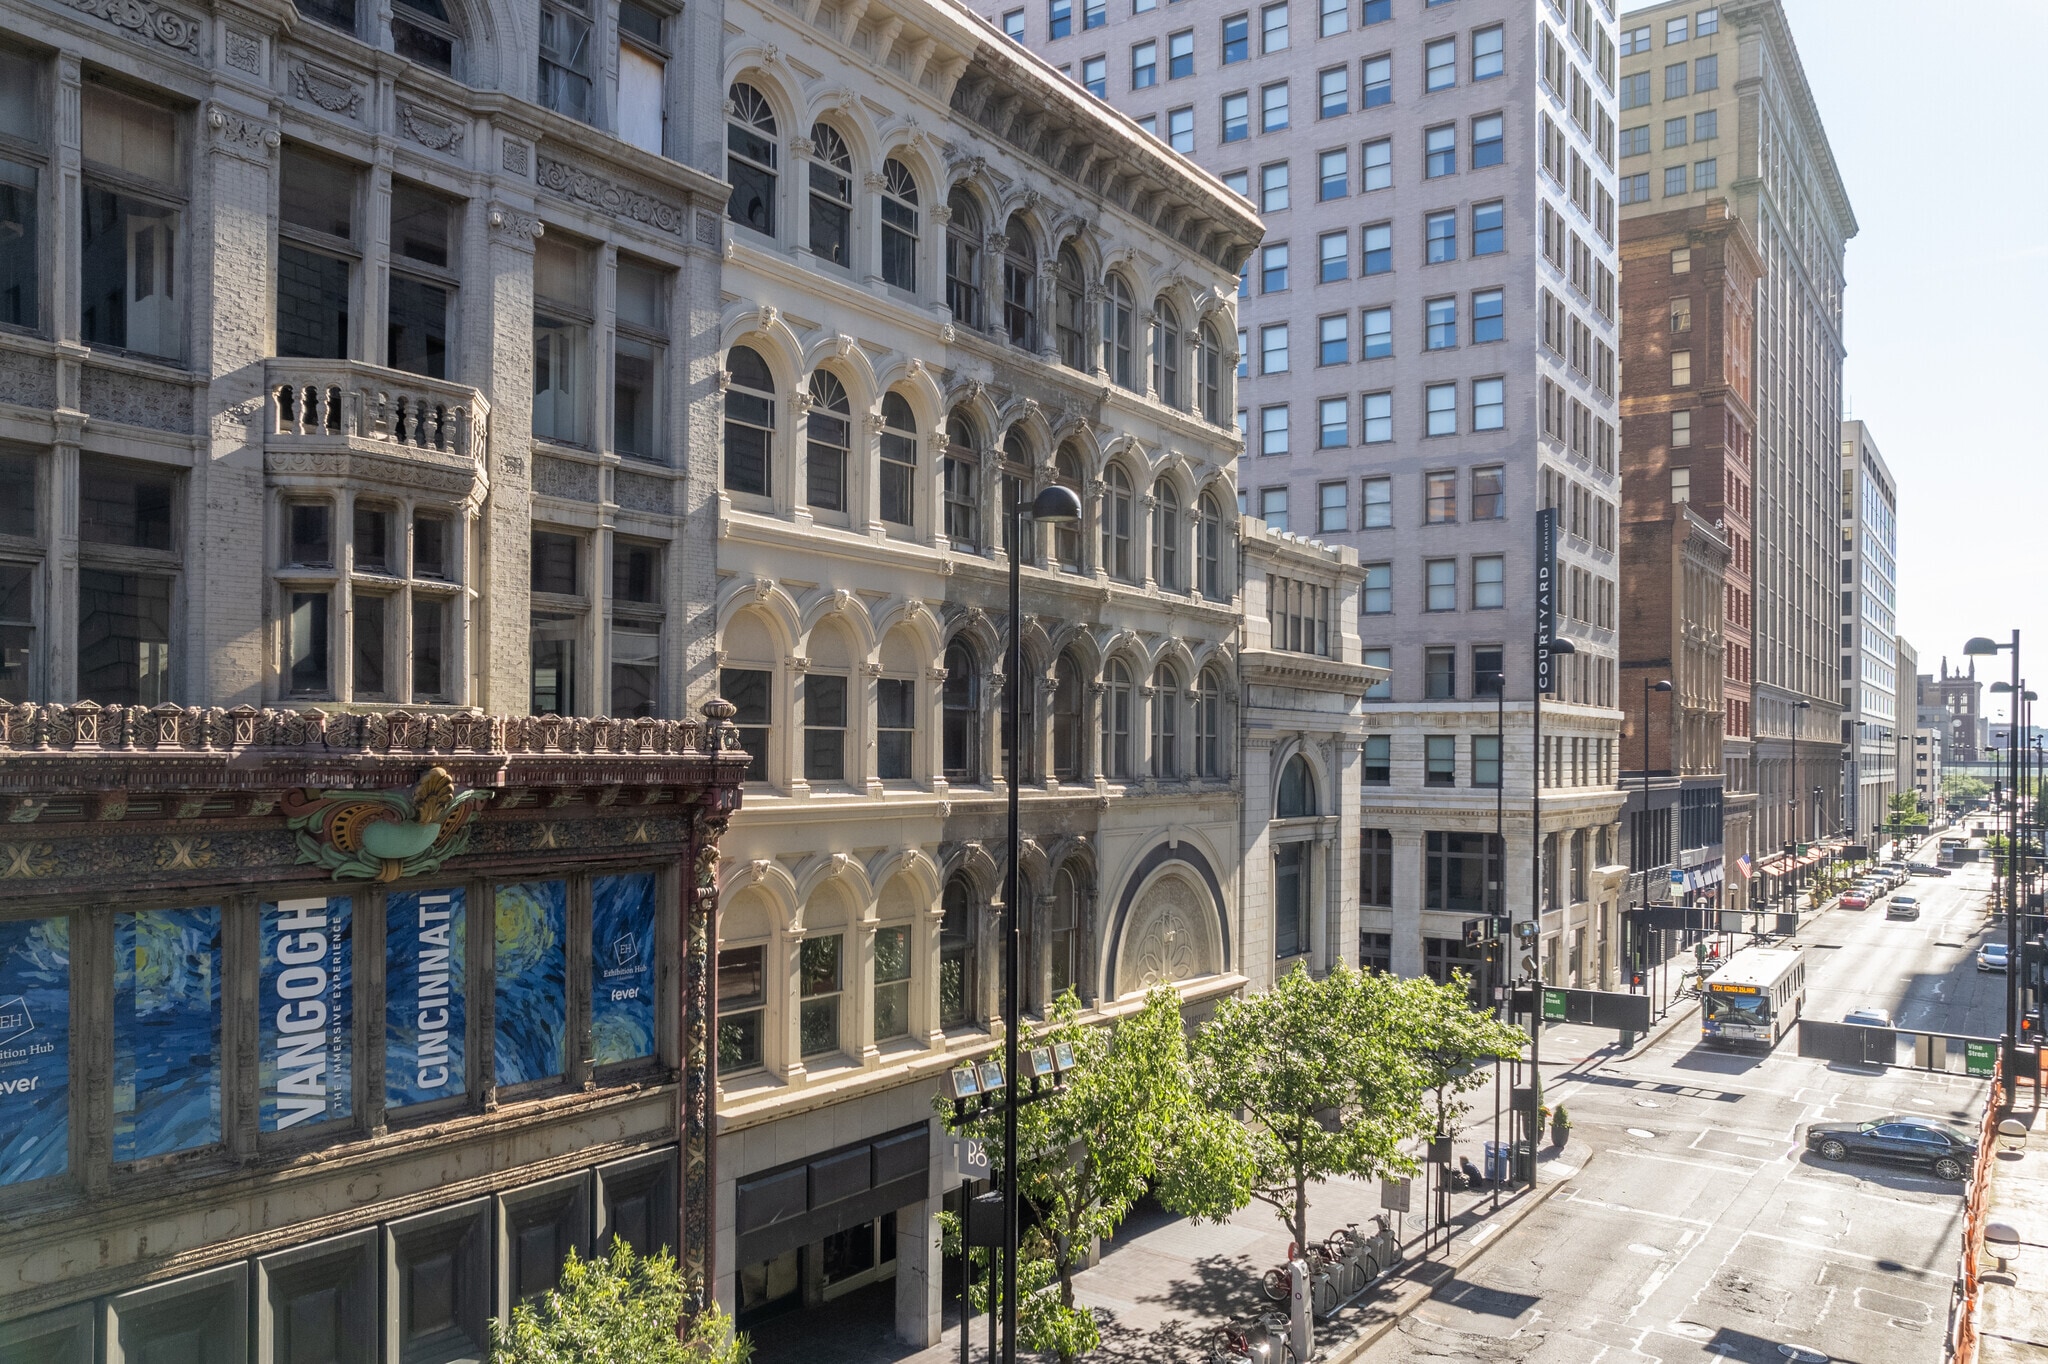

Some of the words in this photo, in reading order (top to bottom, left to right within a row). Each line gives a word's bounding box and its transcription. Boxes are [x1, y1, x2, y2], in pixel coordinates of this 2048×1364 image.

[1539, 567, 1549, 688] COURTYARD
[620, 943, 632, 954] EH
[332, 915, 342, 999] EXPERIENCE
[603, 967, 634, 978] Exhibition
[634, 964, 648, 973] Hub
[417, 894, 451, 1090] CINCINNATI
[611, 987, 640, 1002] fever
[1545, 997, 1561, 1005] Street
[0, 1013, 23, 1029] EH
[29, 1041, 55, 1056] Hub
[333, 1003, 342, 1082] IMMERSIVE
[1967, 1043, 1983, 1051] Vine
[1967, 1050, 1989, 1058] Street
[0, 1075, 39, 1096] ver
[334, 1087, 342, 1109] THE
